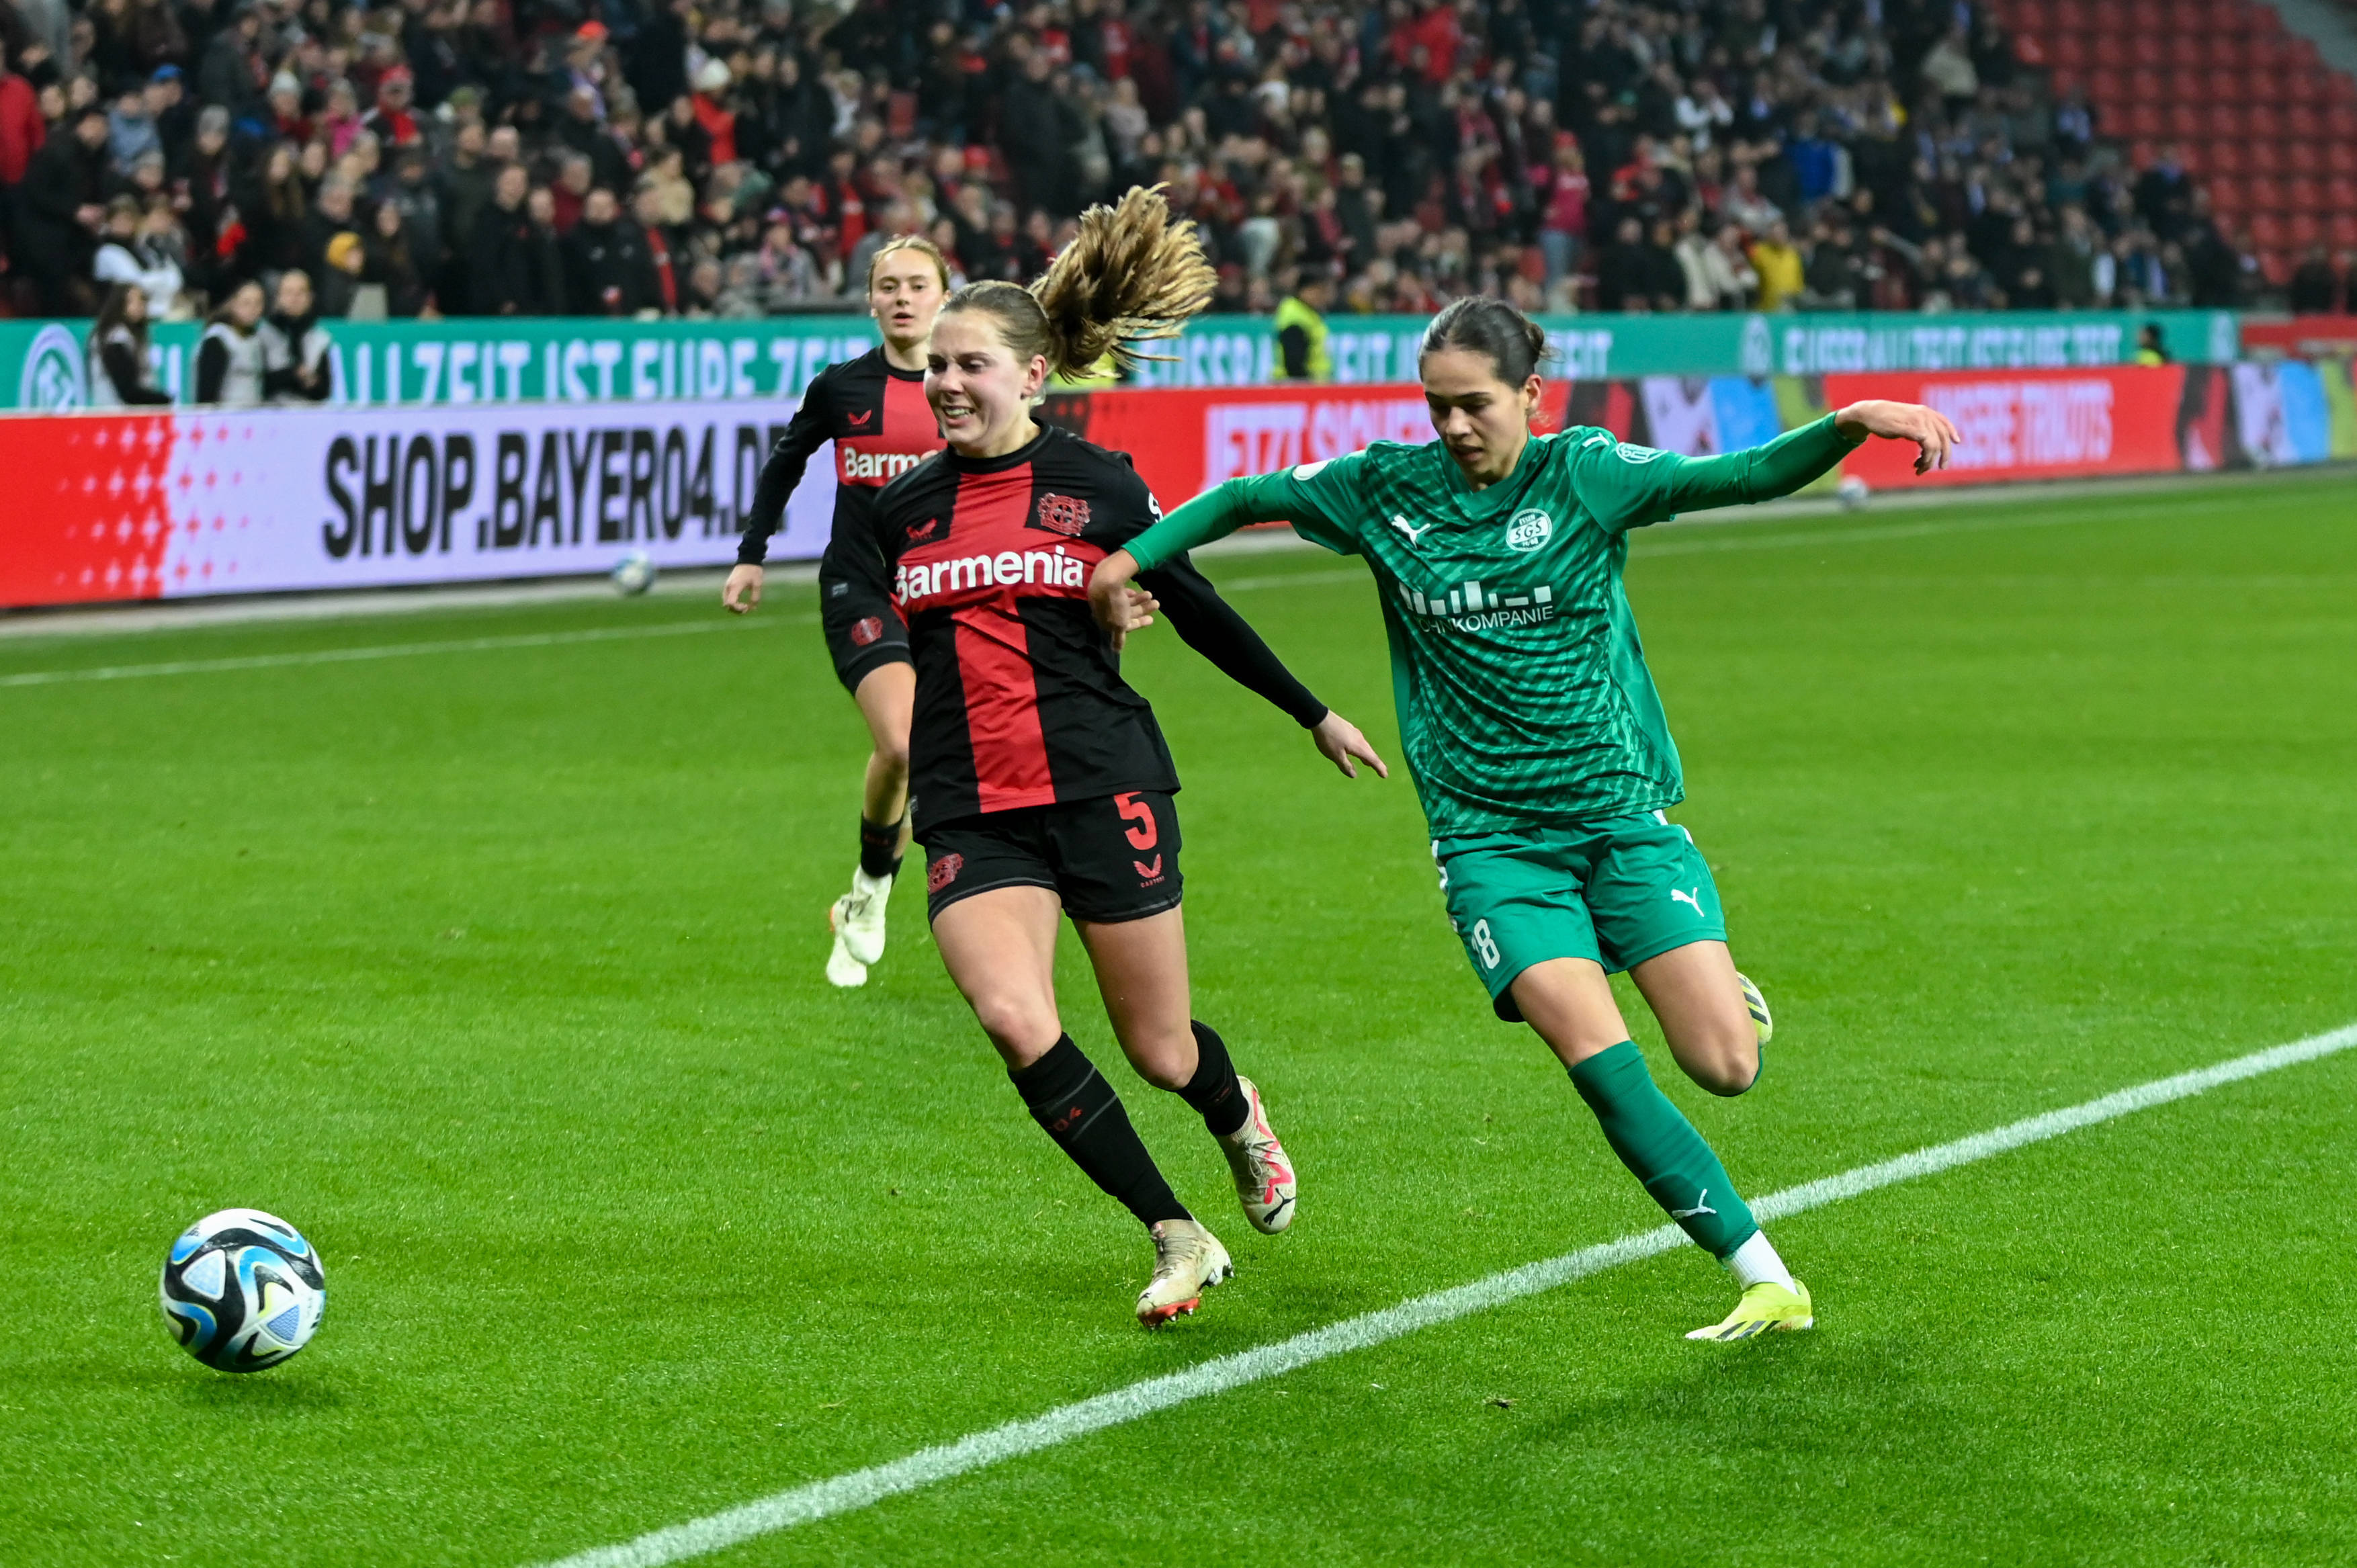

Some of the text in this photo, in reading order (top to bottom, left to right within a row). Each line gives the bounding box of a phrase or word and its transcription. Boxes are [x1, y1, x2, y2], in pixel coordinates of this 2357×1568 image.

[1514, 519, 1542, 541] SGS
[895, 545, 1083, 606] Barmenia
[1113, 791, 1158, 851] 5
